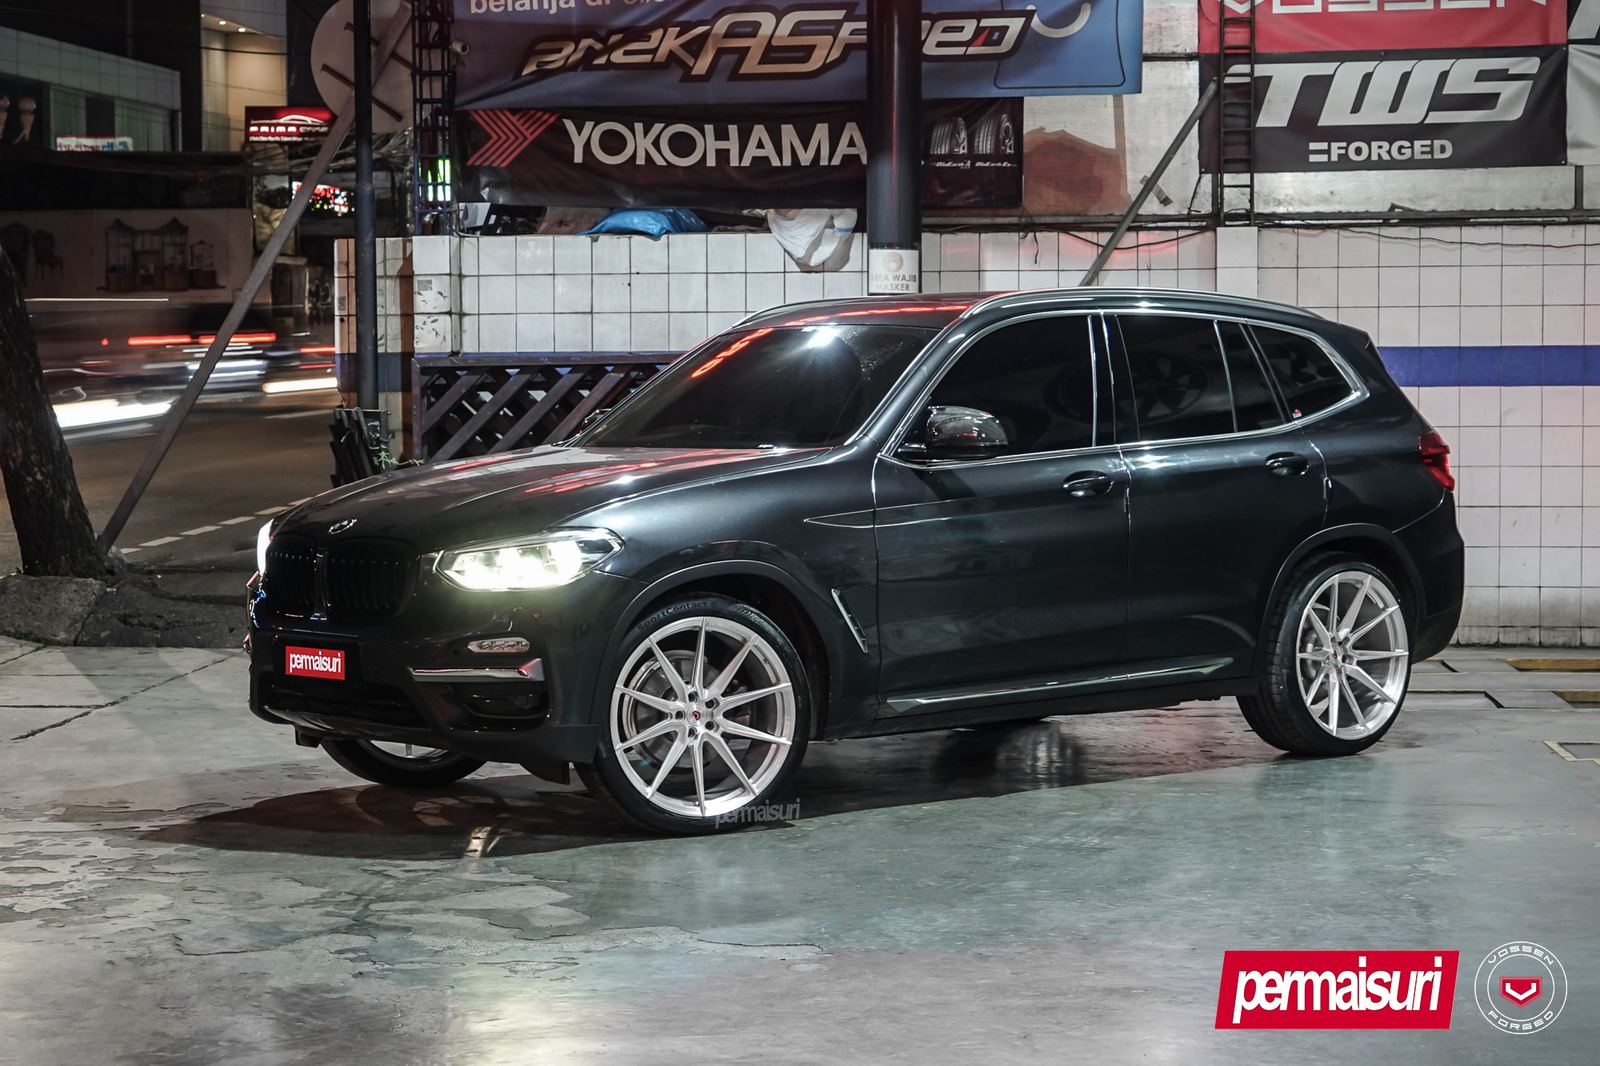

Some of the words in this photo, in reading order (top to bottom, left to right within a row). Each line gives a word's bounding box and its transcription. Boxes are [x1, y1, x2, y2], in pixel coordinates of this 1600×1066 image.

[1224, 57, 1541, 127] TWS
[562, 118, 868, 168] YOKOHAMA
[1330, 139, 1453, 162] FORGED
